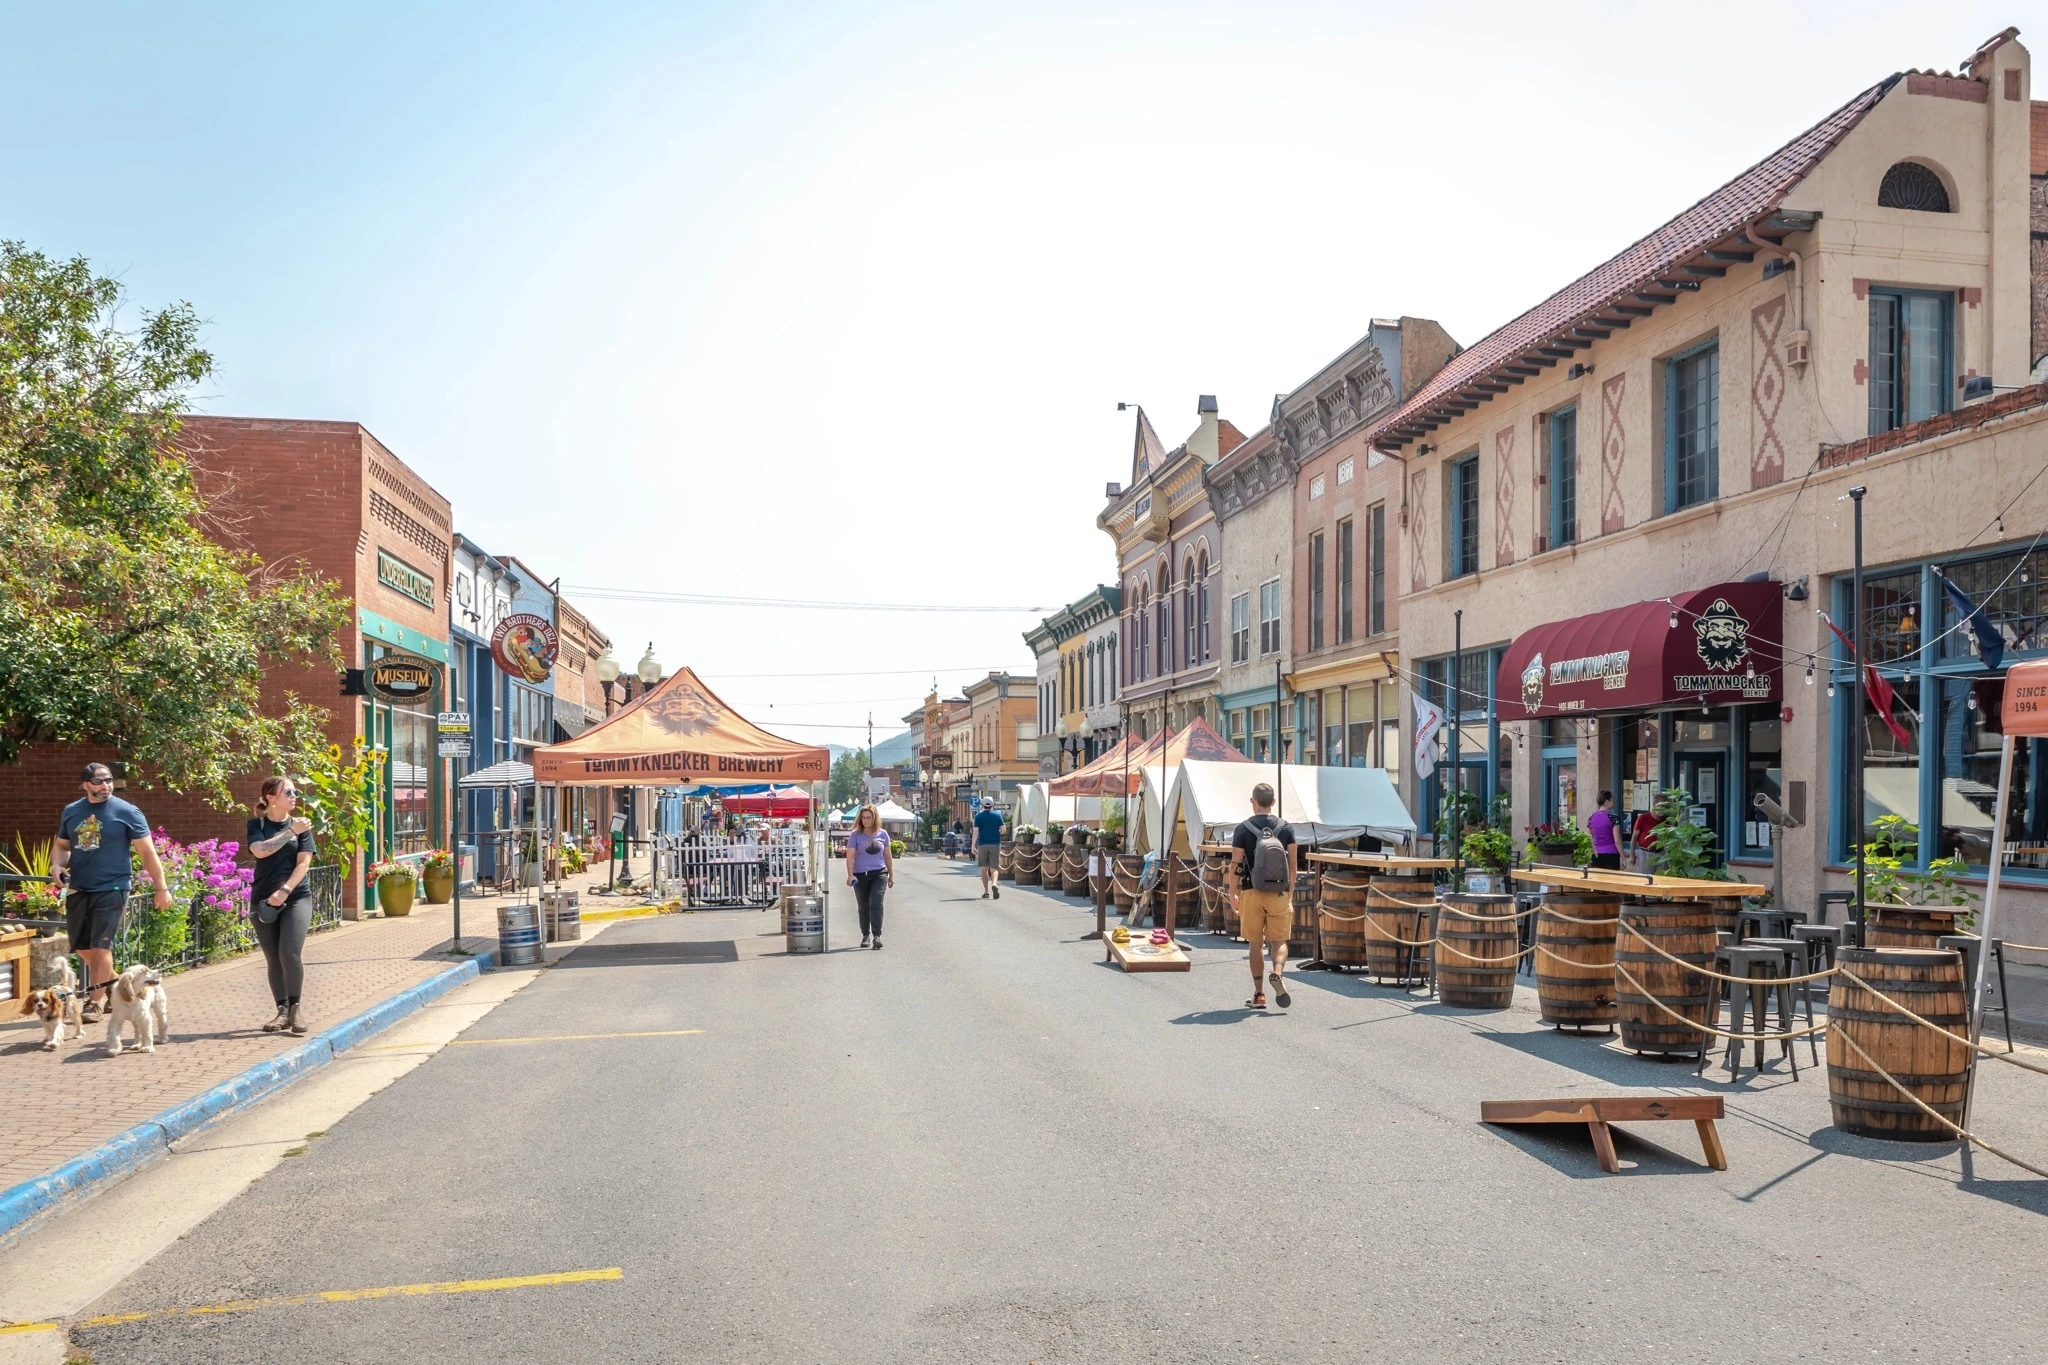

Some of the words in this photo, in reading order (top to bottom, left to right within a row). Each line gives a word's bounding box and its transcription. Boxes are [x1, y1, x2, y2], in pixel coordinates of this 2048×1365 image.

[493, 624, 508, 642] TWO
[506, 615, 547, 630] BROTHERS
[544, 628, 557, 645] DELI
[404, 657, 432, 671] PHOTOS
[1550, 650, 1630, 685] TOMMYKNOCKER
[376, 669, 430, 687] MUSEUM
[1604, 675, 1627, 690] BREWERY
[1674, 675, 1771, 691] TOMMYKNOCKER
[1743, 689, 1769, 697] BREWERY
[2016, 686, 2047, 698] SINCE
[2015, 702, 2038, 713] 1994
[584, 753, 710, 772] TOMMYKNOCKER
[718, 756, 784, 772] BREWERY
[972, 797, 979, 806] P
